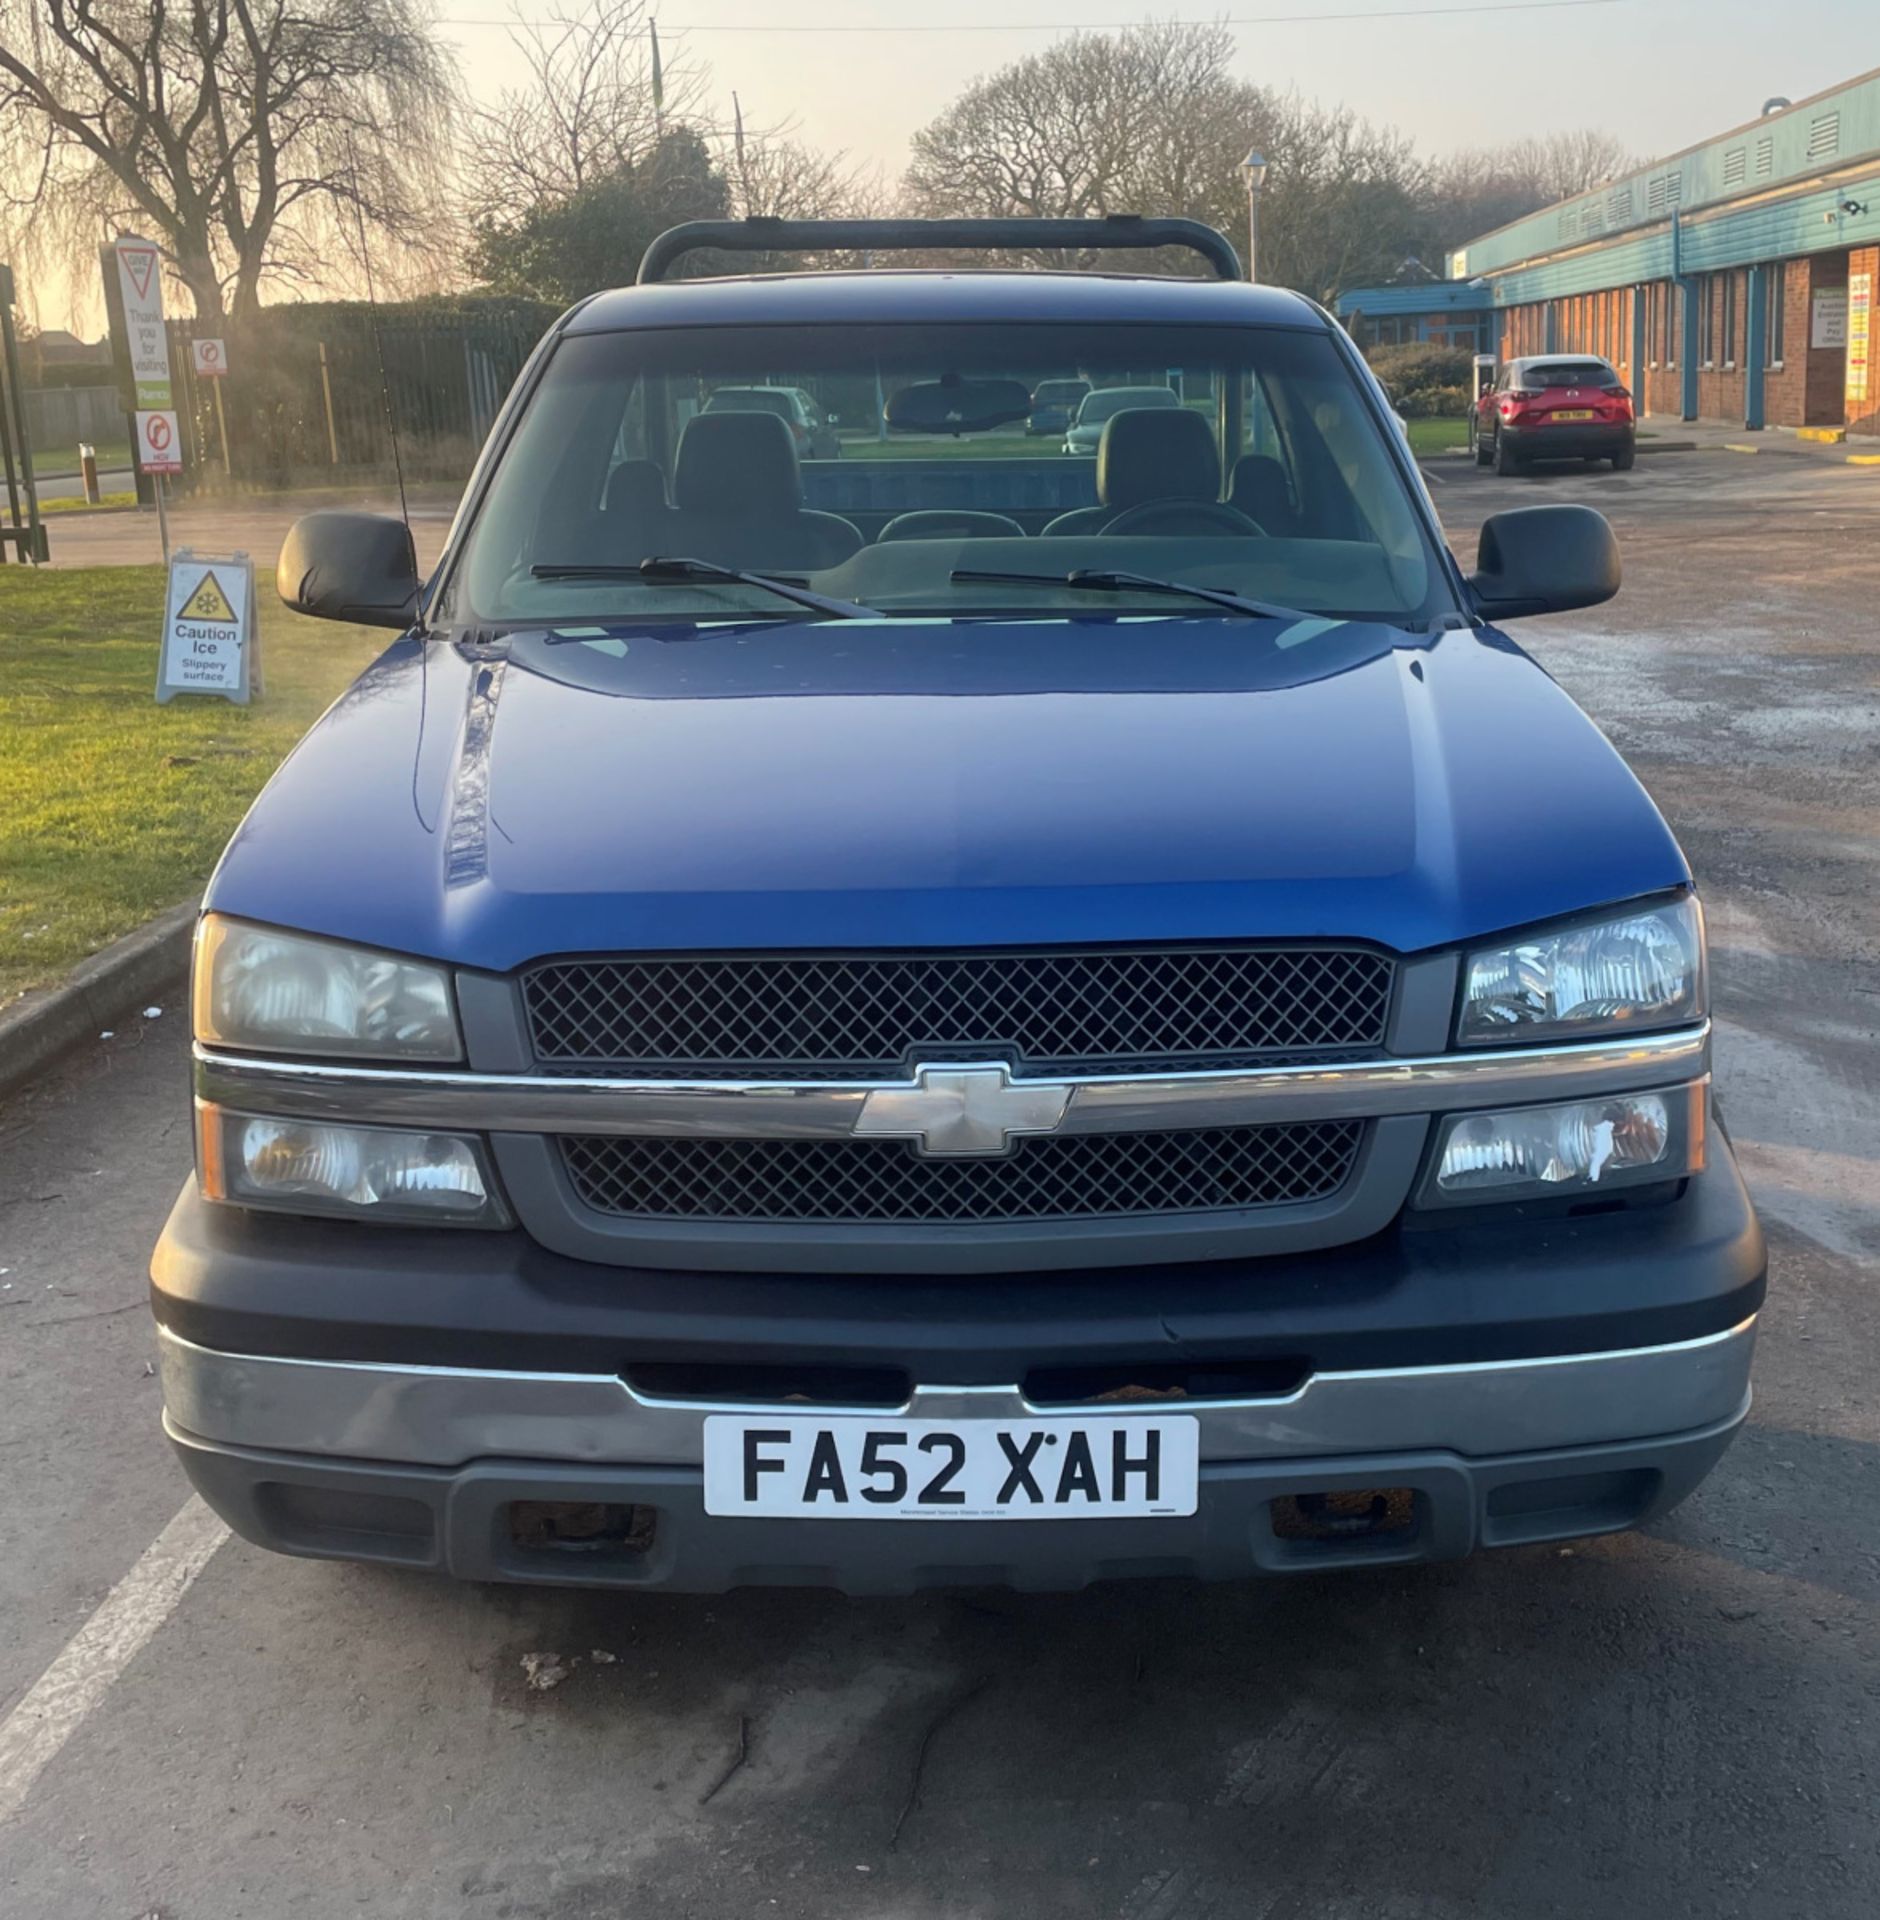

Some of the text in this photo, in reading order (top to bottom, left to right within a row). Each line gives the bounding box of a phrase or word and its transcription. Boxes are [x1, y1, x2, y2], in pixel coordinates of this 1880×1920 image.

[128, 254, 148, 266] GIVE
[129, 308, 161, 323] Thank
[1818, 311, 1848, 319] Entranc
[138, 328, 156, 341] you
[142, 341, 156, 355] for
[135, 360, 167, 375] visiting
[175, 624, 236, 641] Caution
[193, 639, 217, 655] Ice
[181, 658, 227, 673] Slippery
[183, 671, 224, 681] surface
[743, 1429, 1161, 1504] FA52 XAH
